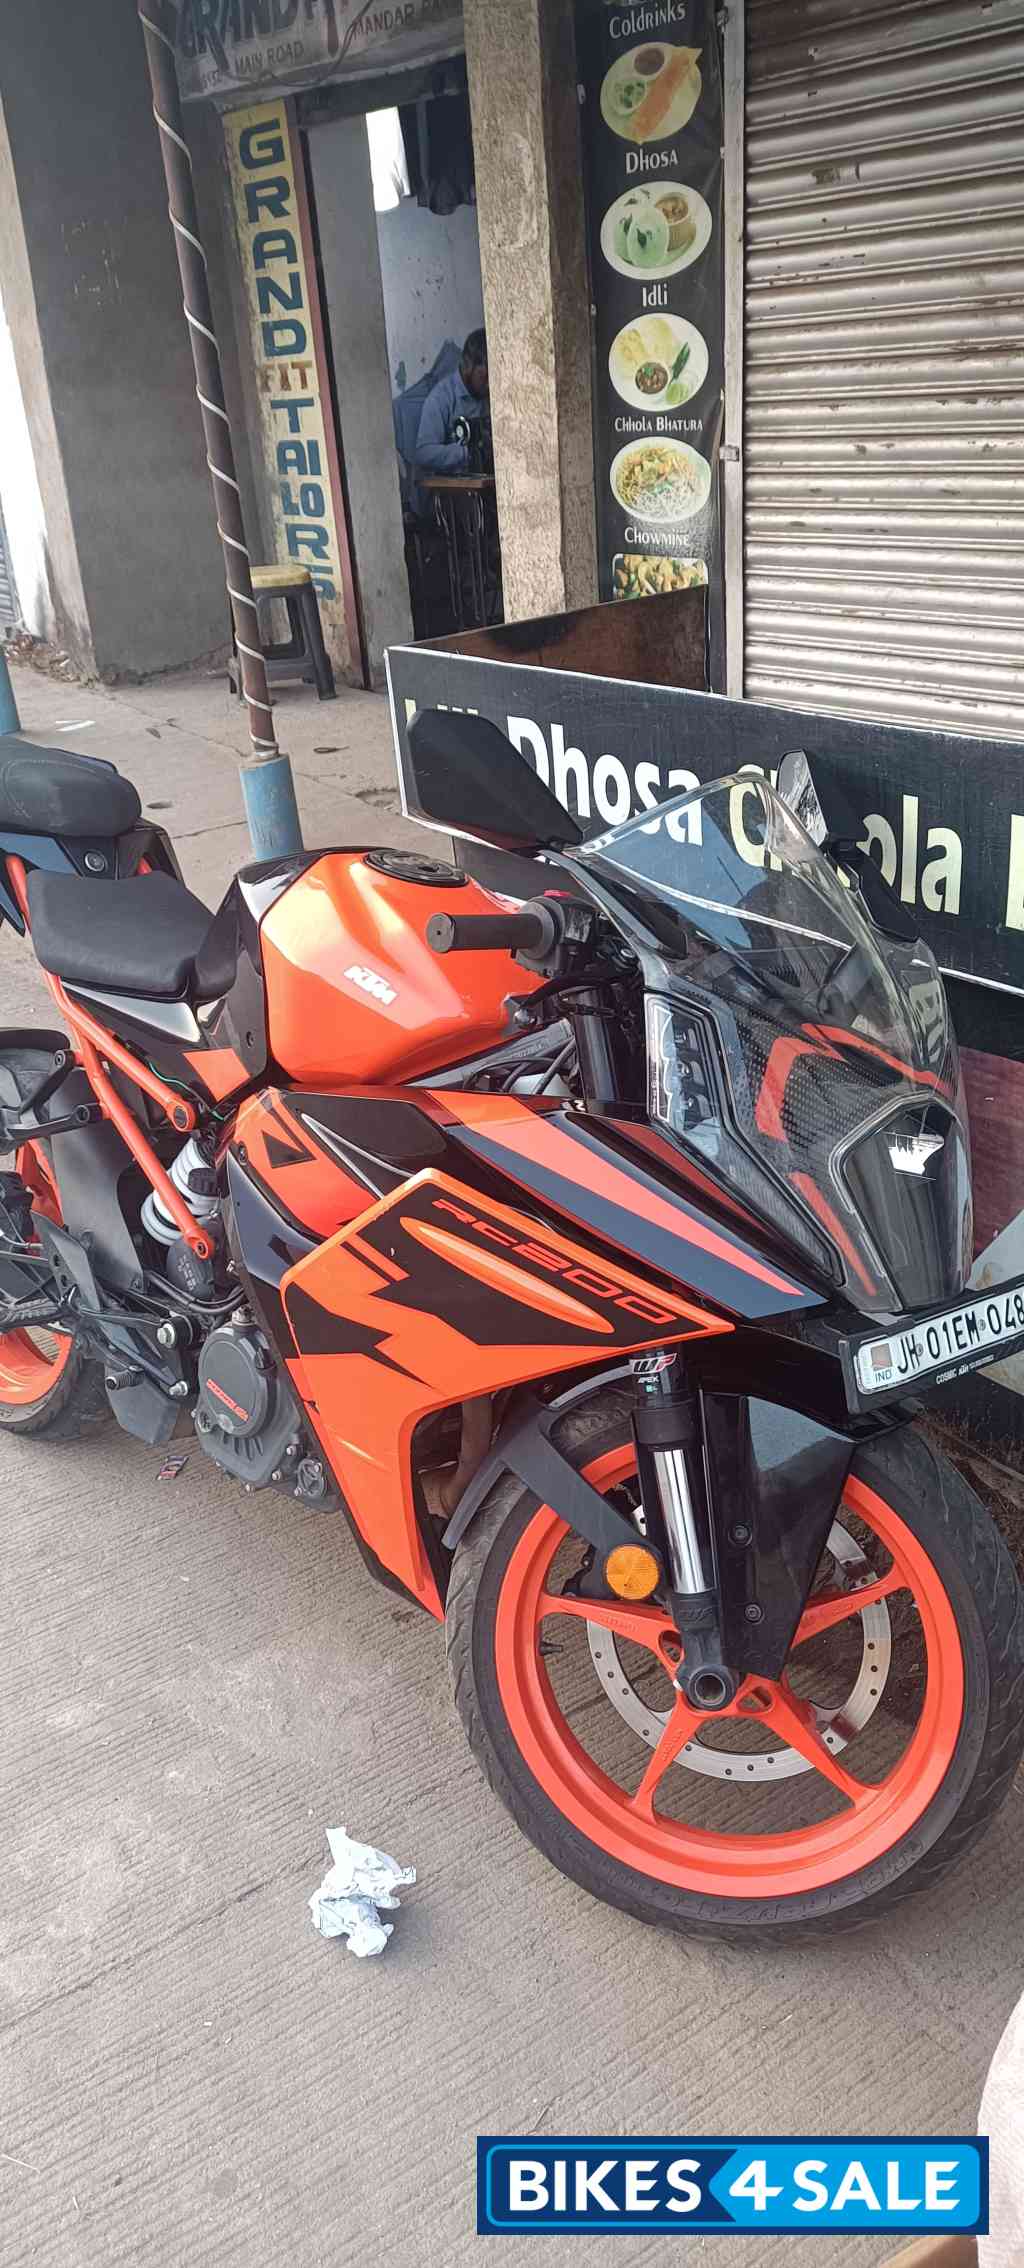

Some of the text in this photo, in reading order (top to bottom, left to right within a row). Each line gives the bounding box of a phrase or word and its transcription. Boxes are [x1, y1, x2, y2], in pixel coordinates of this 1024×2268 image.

[266, 41, 304, 65] ROAD
[239, 118, 306, 357] GRAND
[642, 284, 668, 307] Idli
[344, 965, 397, 1006] KTM
[897, 1334, 920, 1373] JH
[926, 1311, 980, 1360] 01EM
[874, 1371, 892, 1384] IND
